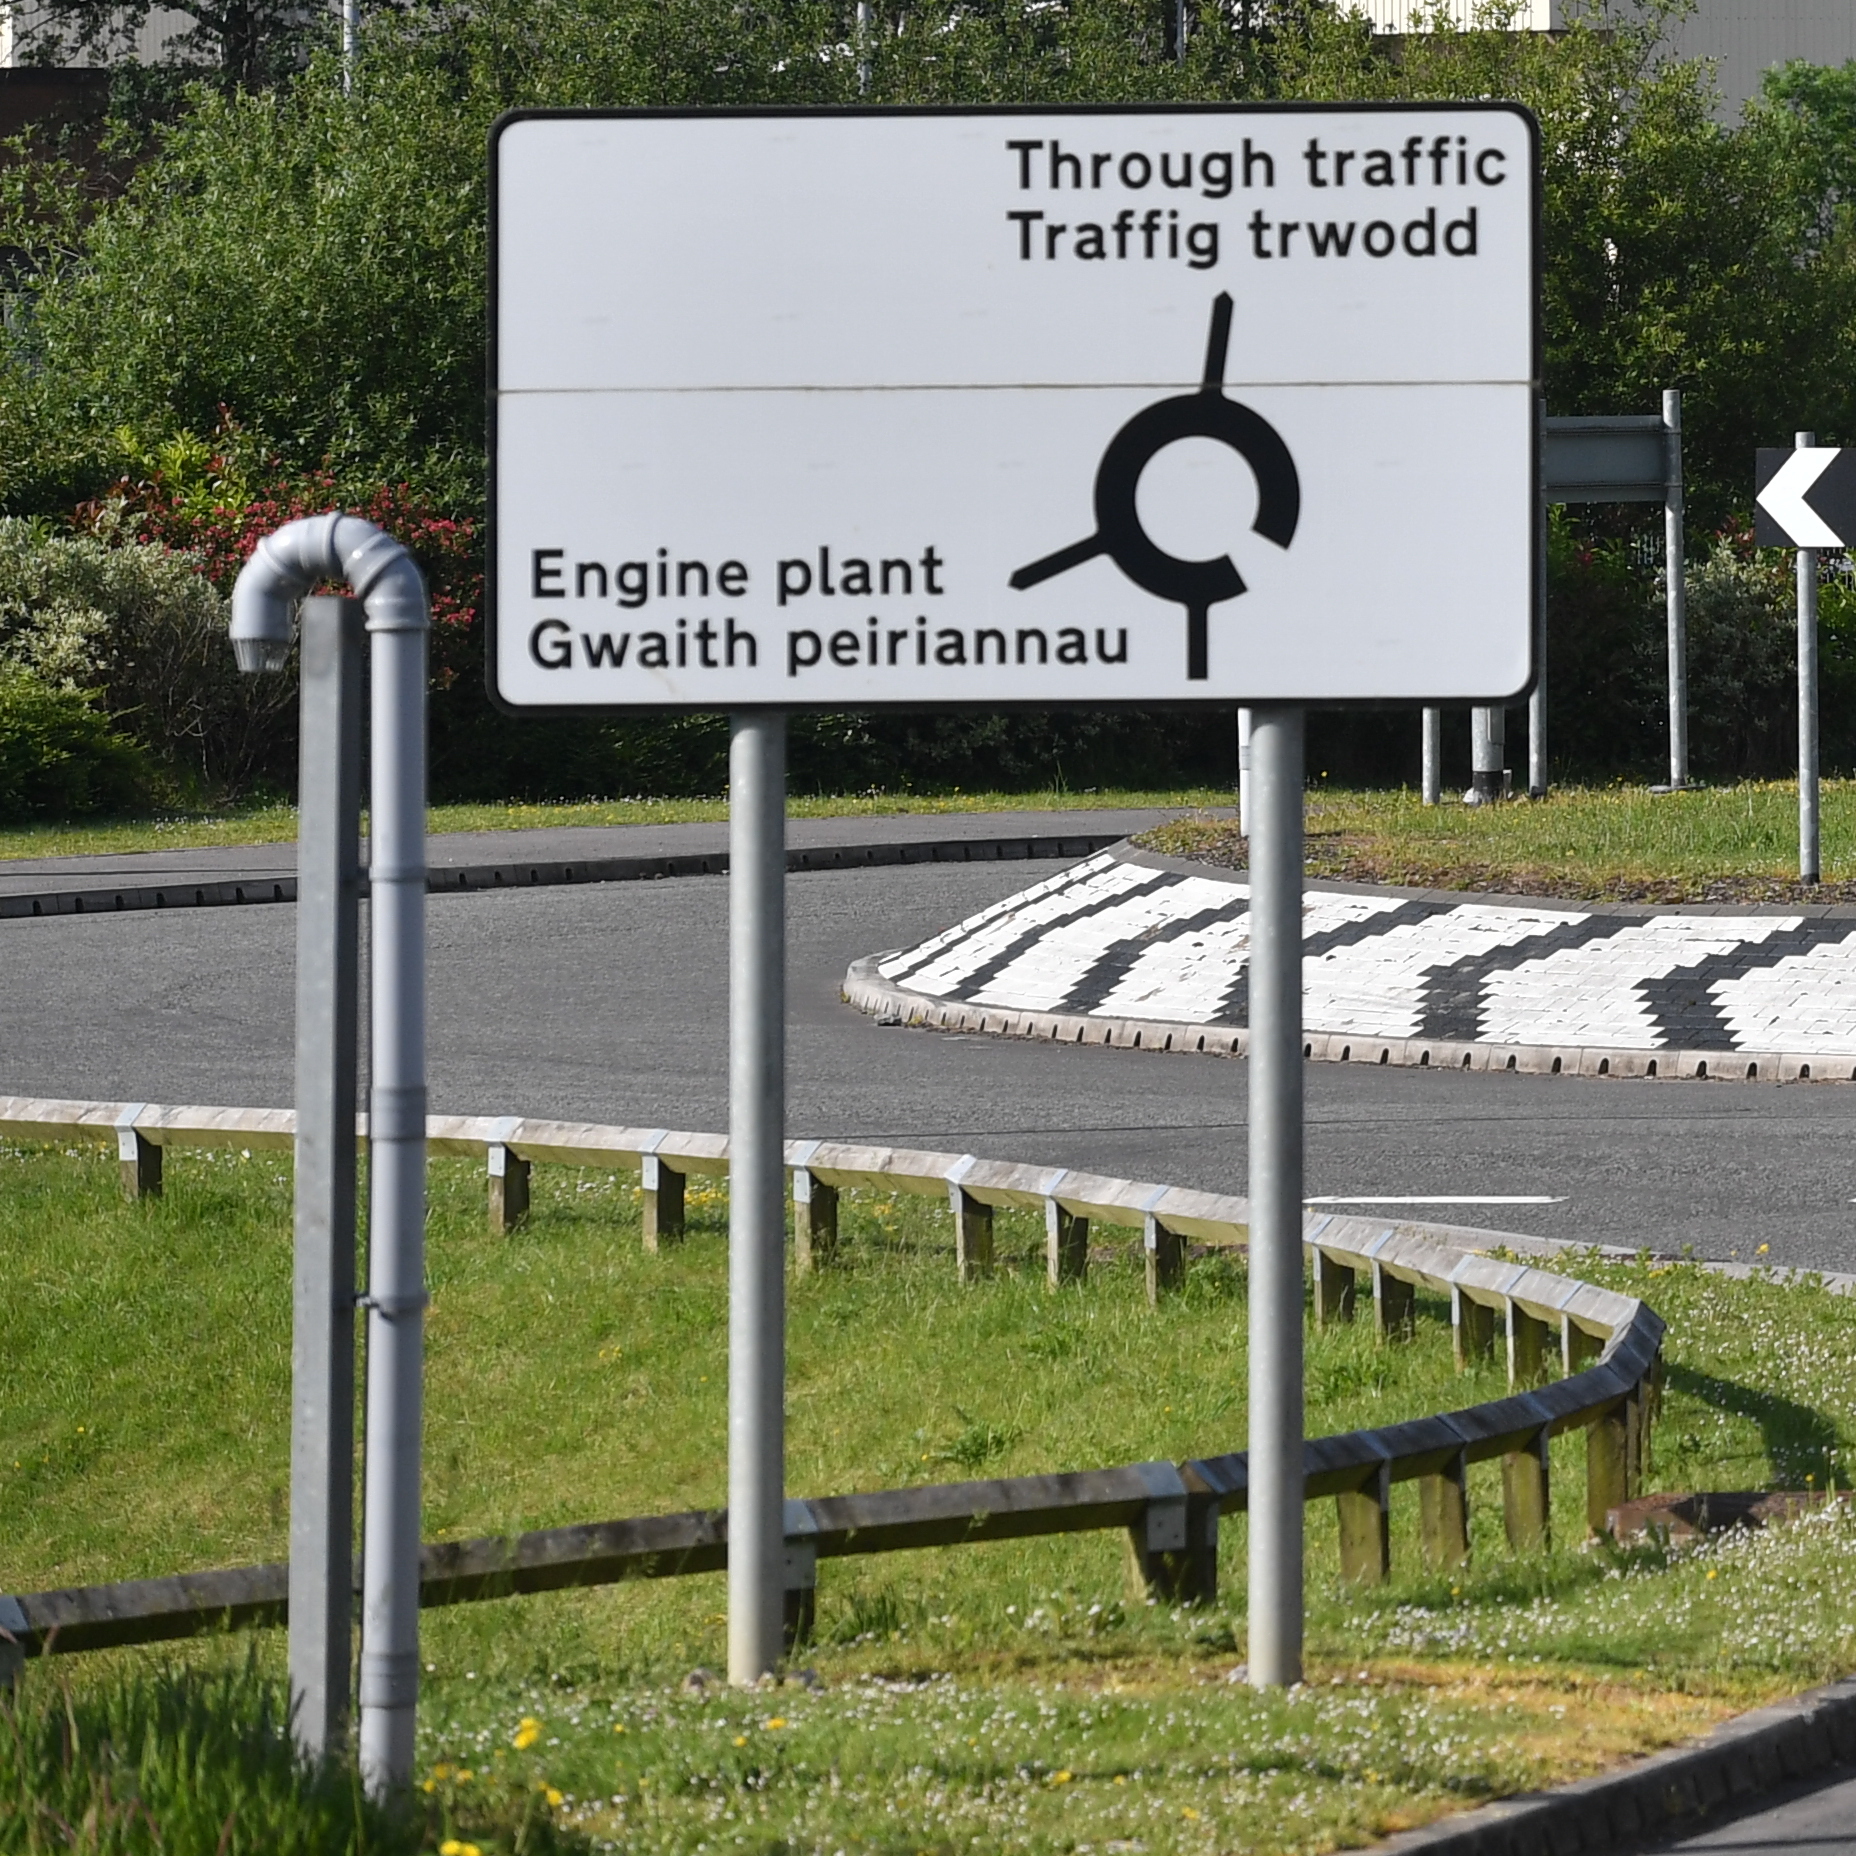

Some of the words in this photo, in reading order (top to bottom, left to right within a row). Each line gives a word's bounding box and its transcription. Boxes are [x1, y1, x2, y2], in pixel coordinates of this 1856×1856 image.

[1006, 137, 1275, 199] Through
[1303, 135, 1506, 188] traffic
[1006, 210, 1219, 270] Traffig
[1247, 207, 1478, 260] trwodd
[532, 547, 749, 609] Engine
[777, 545, 944, 607] plant
[529, 617, 757, 670] Gwaith
[787, 615, 1128, 677] peiriannau
